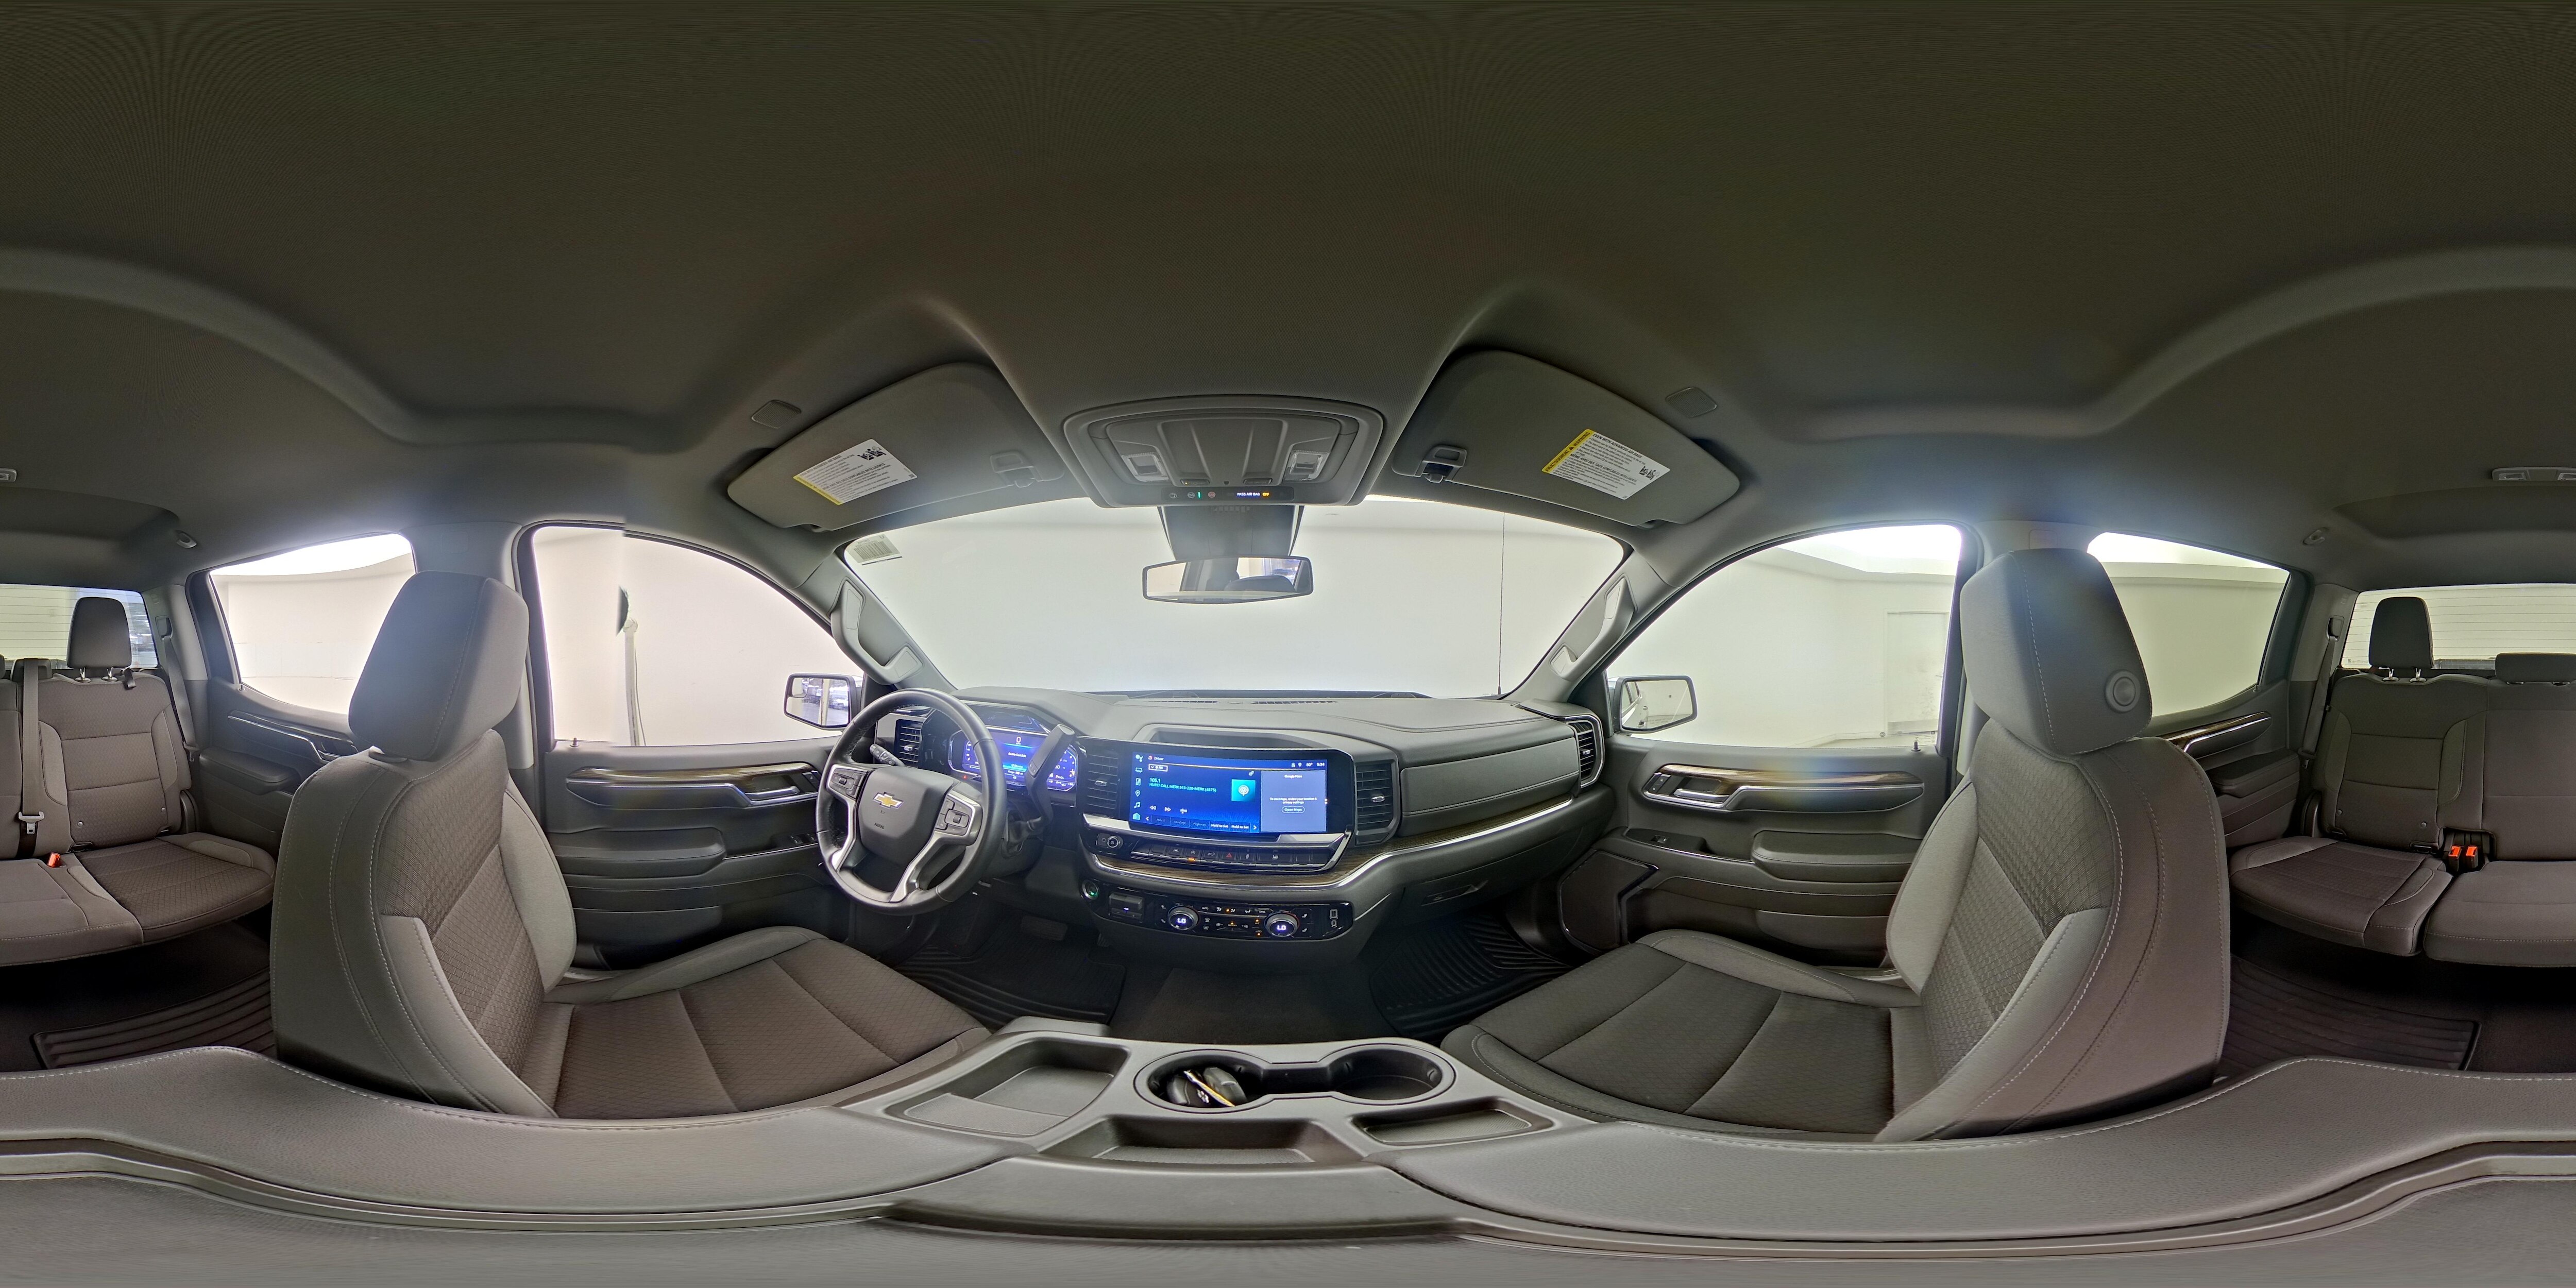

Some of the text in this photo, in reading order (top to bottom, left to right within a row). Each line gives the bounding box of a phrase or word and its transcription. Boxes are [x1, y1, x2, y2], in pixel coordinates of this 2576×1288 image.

[1572, 431, 1590, 446] WARNING
[1610, 442, 1629, 451] ADVANCED
[1544, 450, 1570, 471] AVERTISSEMENT
